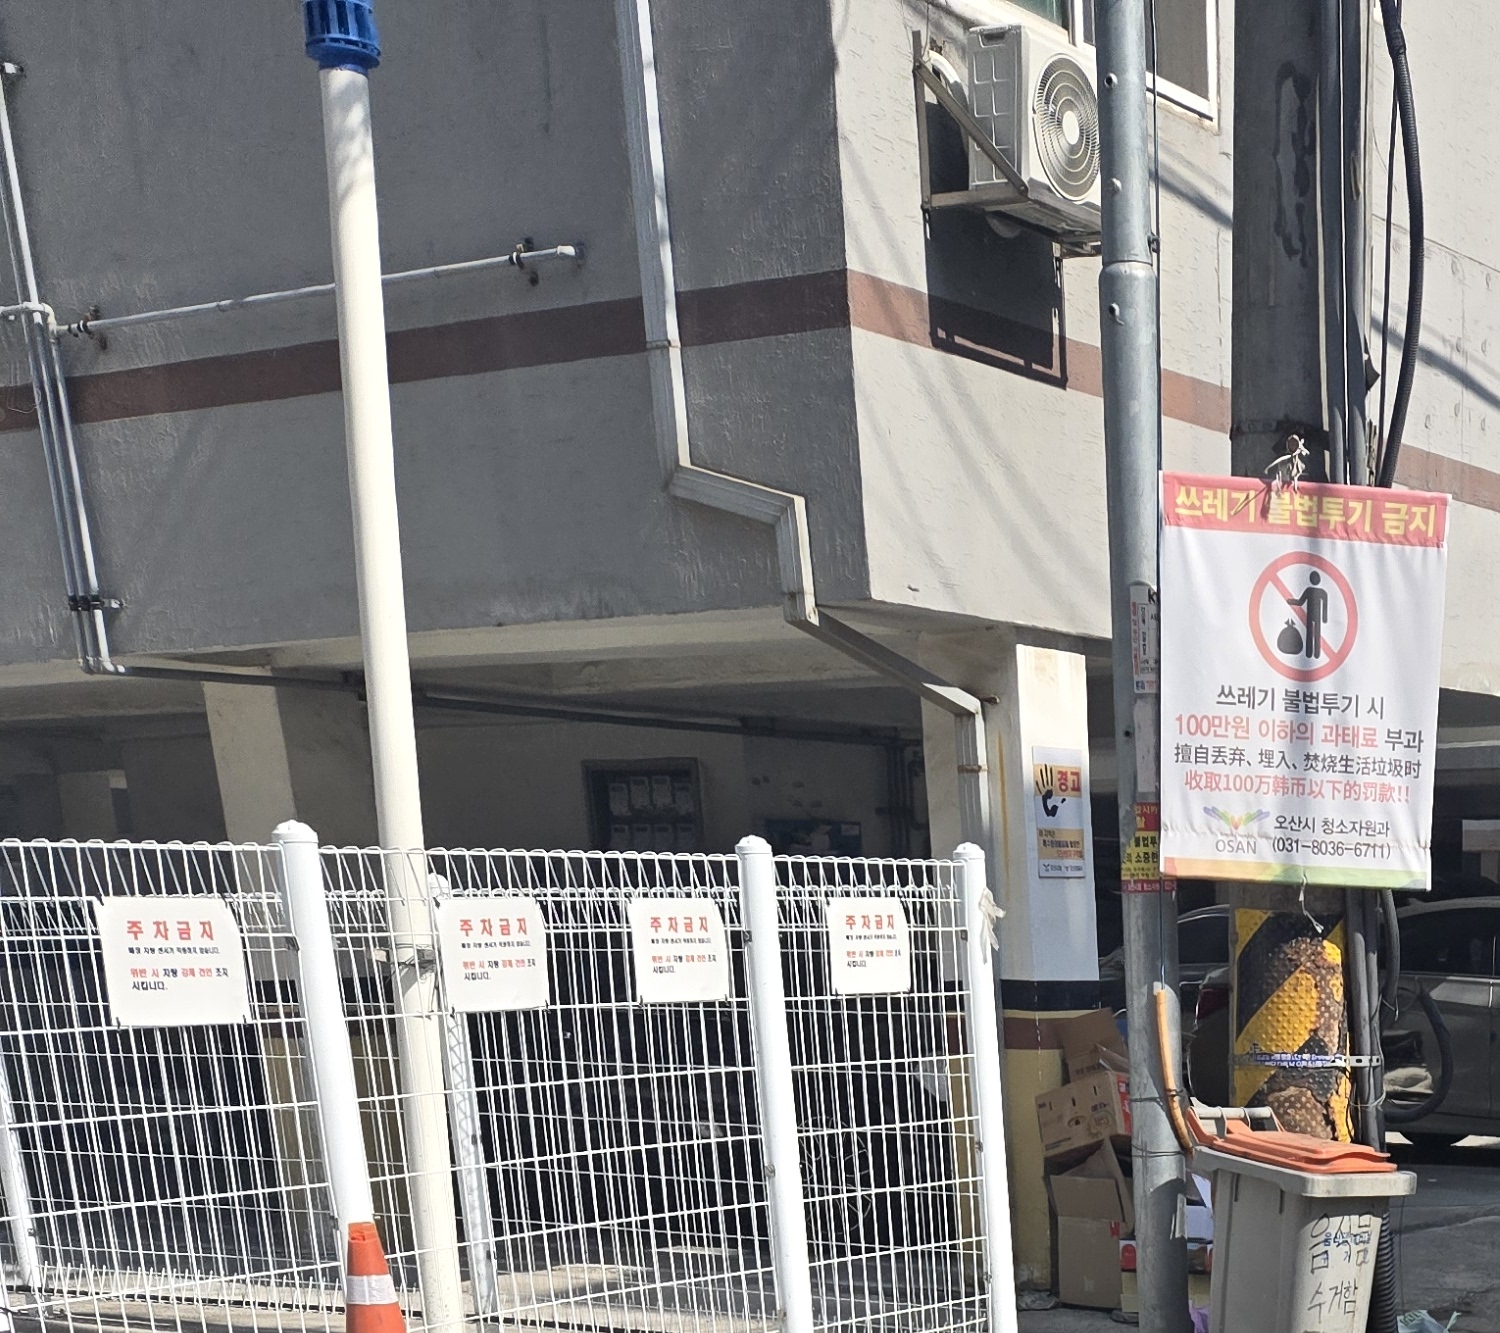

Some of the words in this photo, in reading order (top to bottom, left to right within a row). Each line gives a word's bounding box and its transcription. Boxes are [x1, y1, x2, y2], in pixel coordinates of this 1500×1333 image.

[1175, 484, 1256, 523] 쓰레기
[1268, 490, 1371, 533] 불법투기
[1382, 502, 1437, 538] 금지
[1216, 684, 1275, 711] 쓰레기
[1282, 688, 1359, 718] 불법투기
[1366, 696, 1384, 720] 시
[1175, 714, 1250, 740] 100만원
[1258, 719, 1315, 746] 이하의
[1321, 723, 1379, 749] 과태료
[1384, 728, 1424, 753] 부과
[1057, 769, 1082, 793] 경고
[1273, 815, 1316, 834] 오산시
[1321, 817, 1390, 837] 청소자원과
[1215, 839, 1257, 855] OSAN
[1272, 836, 1391, 859] (031-8036-6711)
[126, 920, 214, 941] 주차금지
[459, 917, 528, 937] 주차금지
[650, 916, 709, 934] 주차금지
[845, 914, 895, 931] 주차금지
[1307, 1278, 1359, 1324] 수거함
